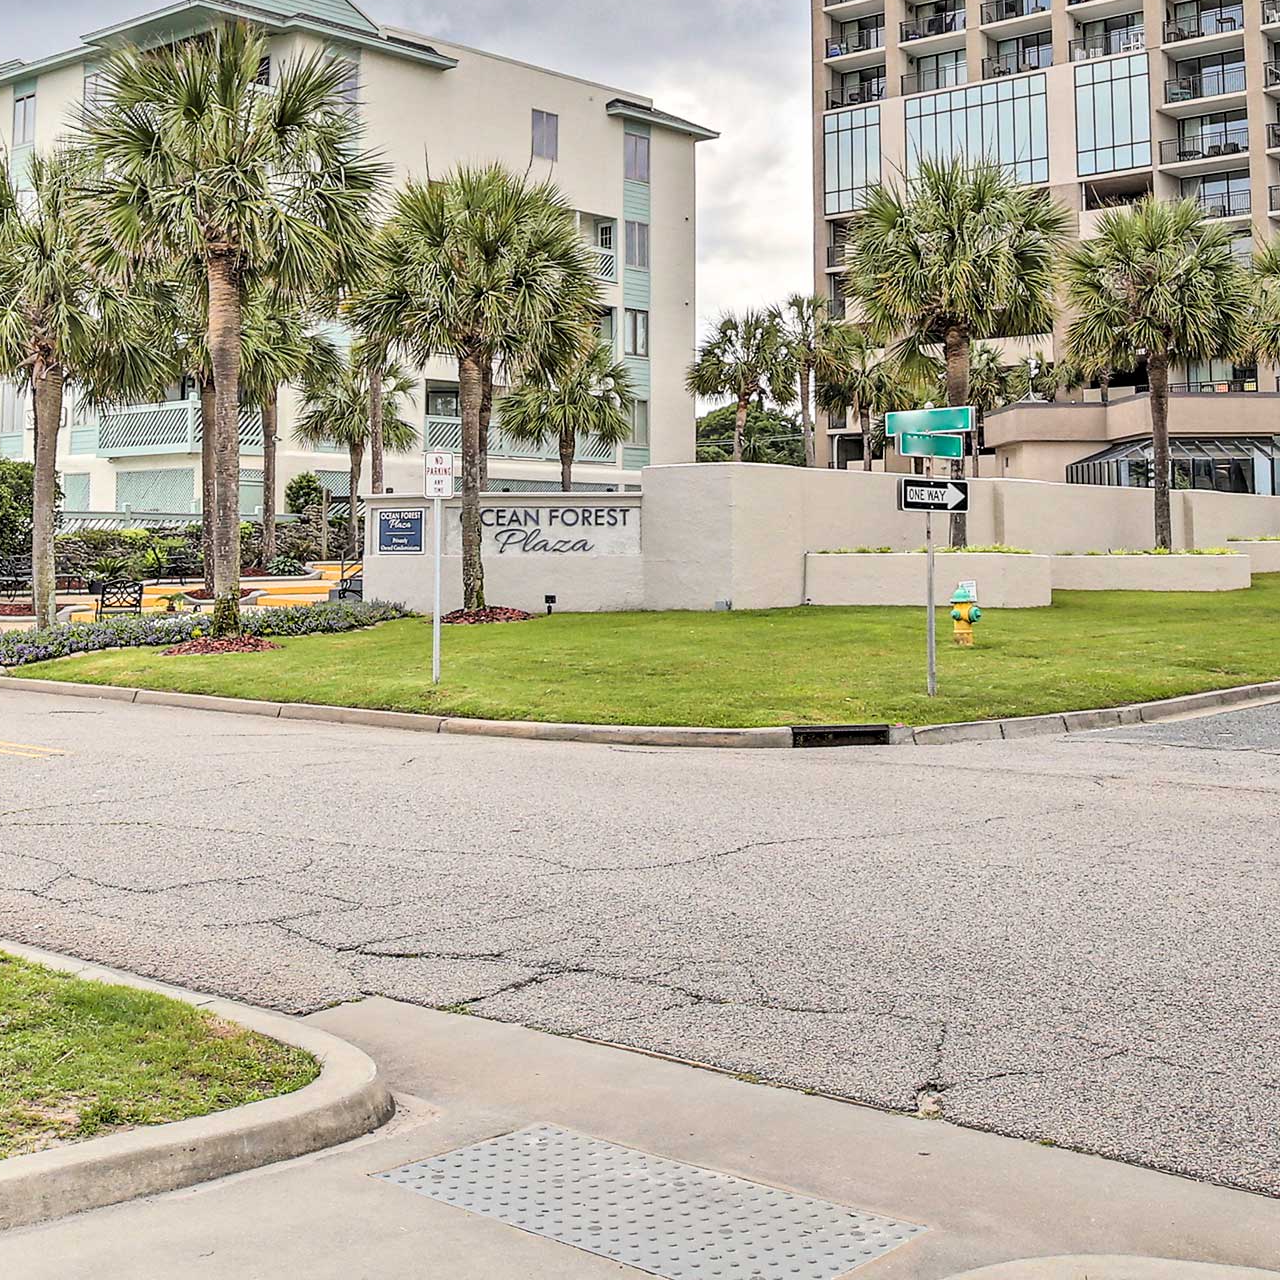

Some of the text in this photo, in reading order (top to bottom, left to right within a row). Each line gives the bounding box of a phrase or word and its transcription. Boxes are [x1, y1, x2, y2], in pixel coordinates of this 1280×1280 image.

[435, 456, 443, 465] NO
[426, 467, 451, 475] PARKING
[909, 488, 946, 501] ONE WAY
[380, 512, 400, 520] OCEAN
[460, 509, 630, 527] CEAN FOREST
[388, 519, 412, 529] Plaza
[494, 528, 595, 554] Plaza
